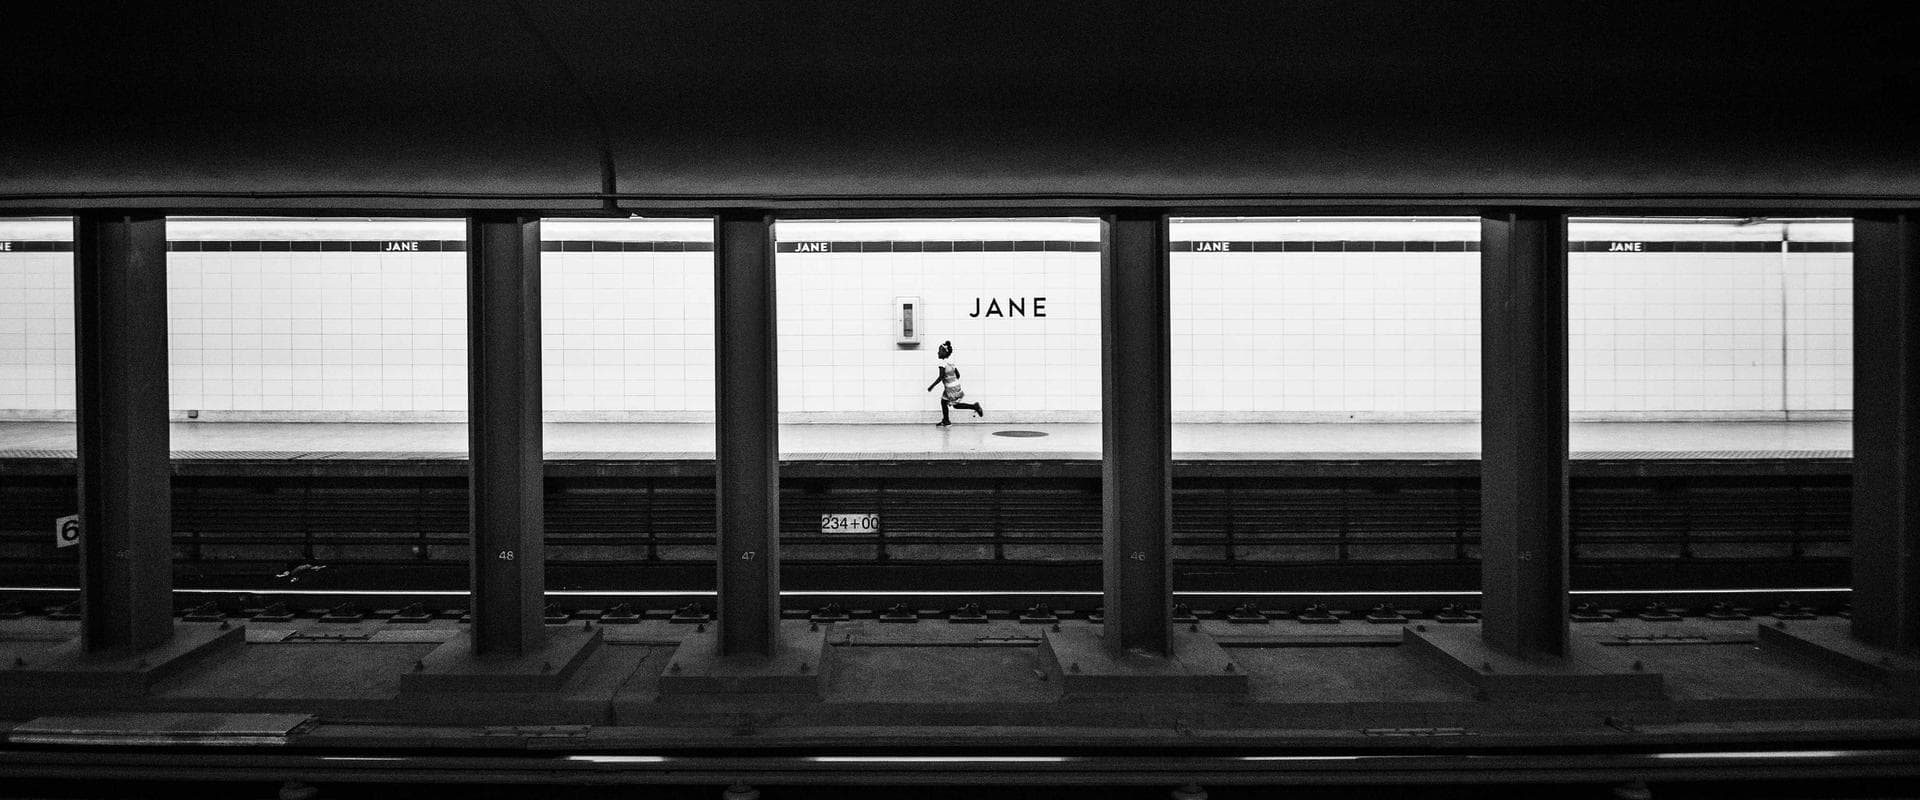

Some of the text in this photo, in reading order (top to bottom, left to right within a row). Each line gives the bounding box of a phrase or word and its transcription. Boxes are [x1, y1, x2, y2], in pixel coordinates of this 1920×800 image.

[386, 242, 419, 251] JANE
[795, 242, 828, 252] JANE
[1197, 242, 1230, 252] JANE
[1608, 242, 1642, 252] JANE
[969, 297, 1047, 318] JANE
[822, 516, 880, 530] 234+00
[62, 520, 79, 541] 6
[498, 550, 514, 560] 48
[741, 551, 755, 560] 47
[1130, 551, 1146, 561] 46
